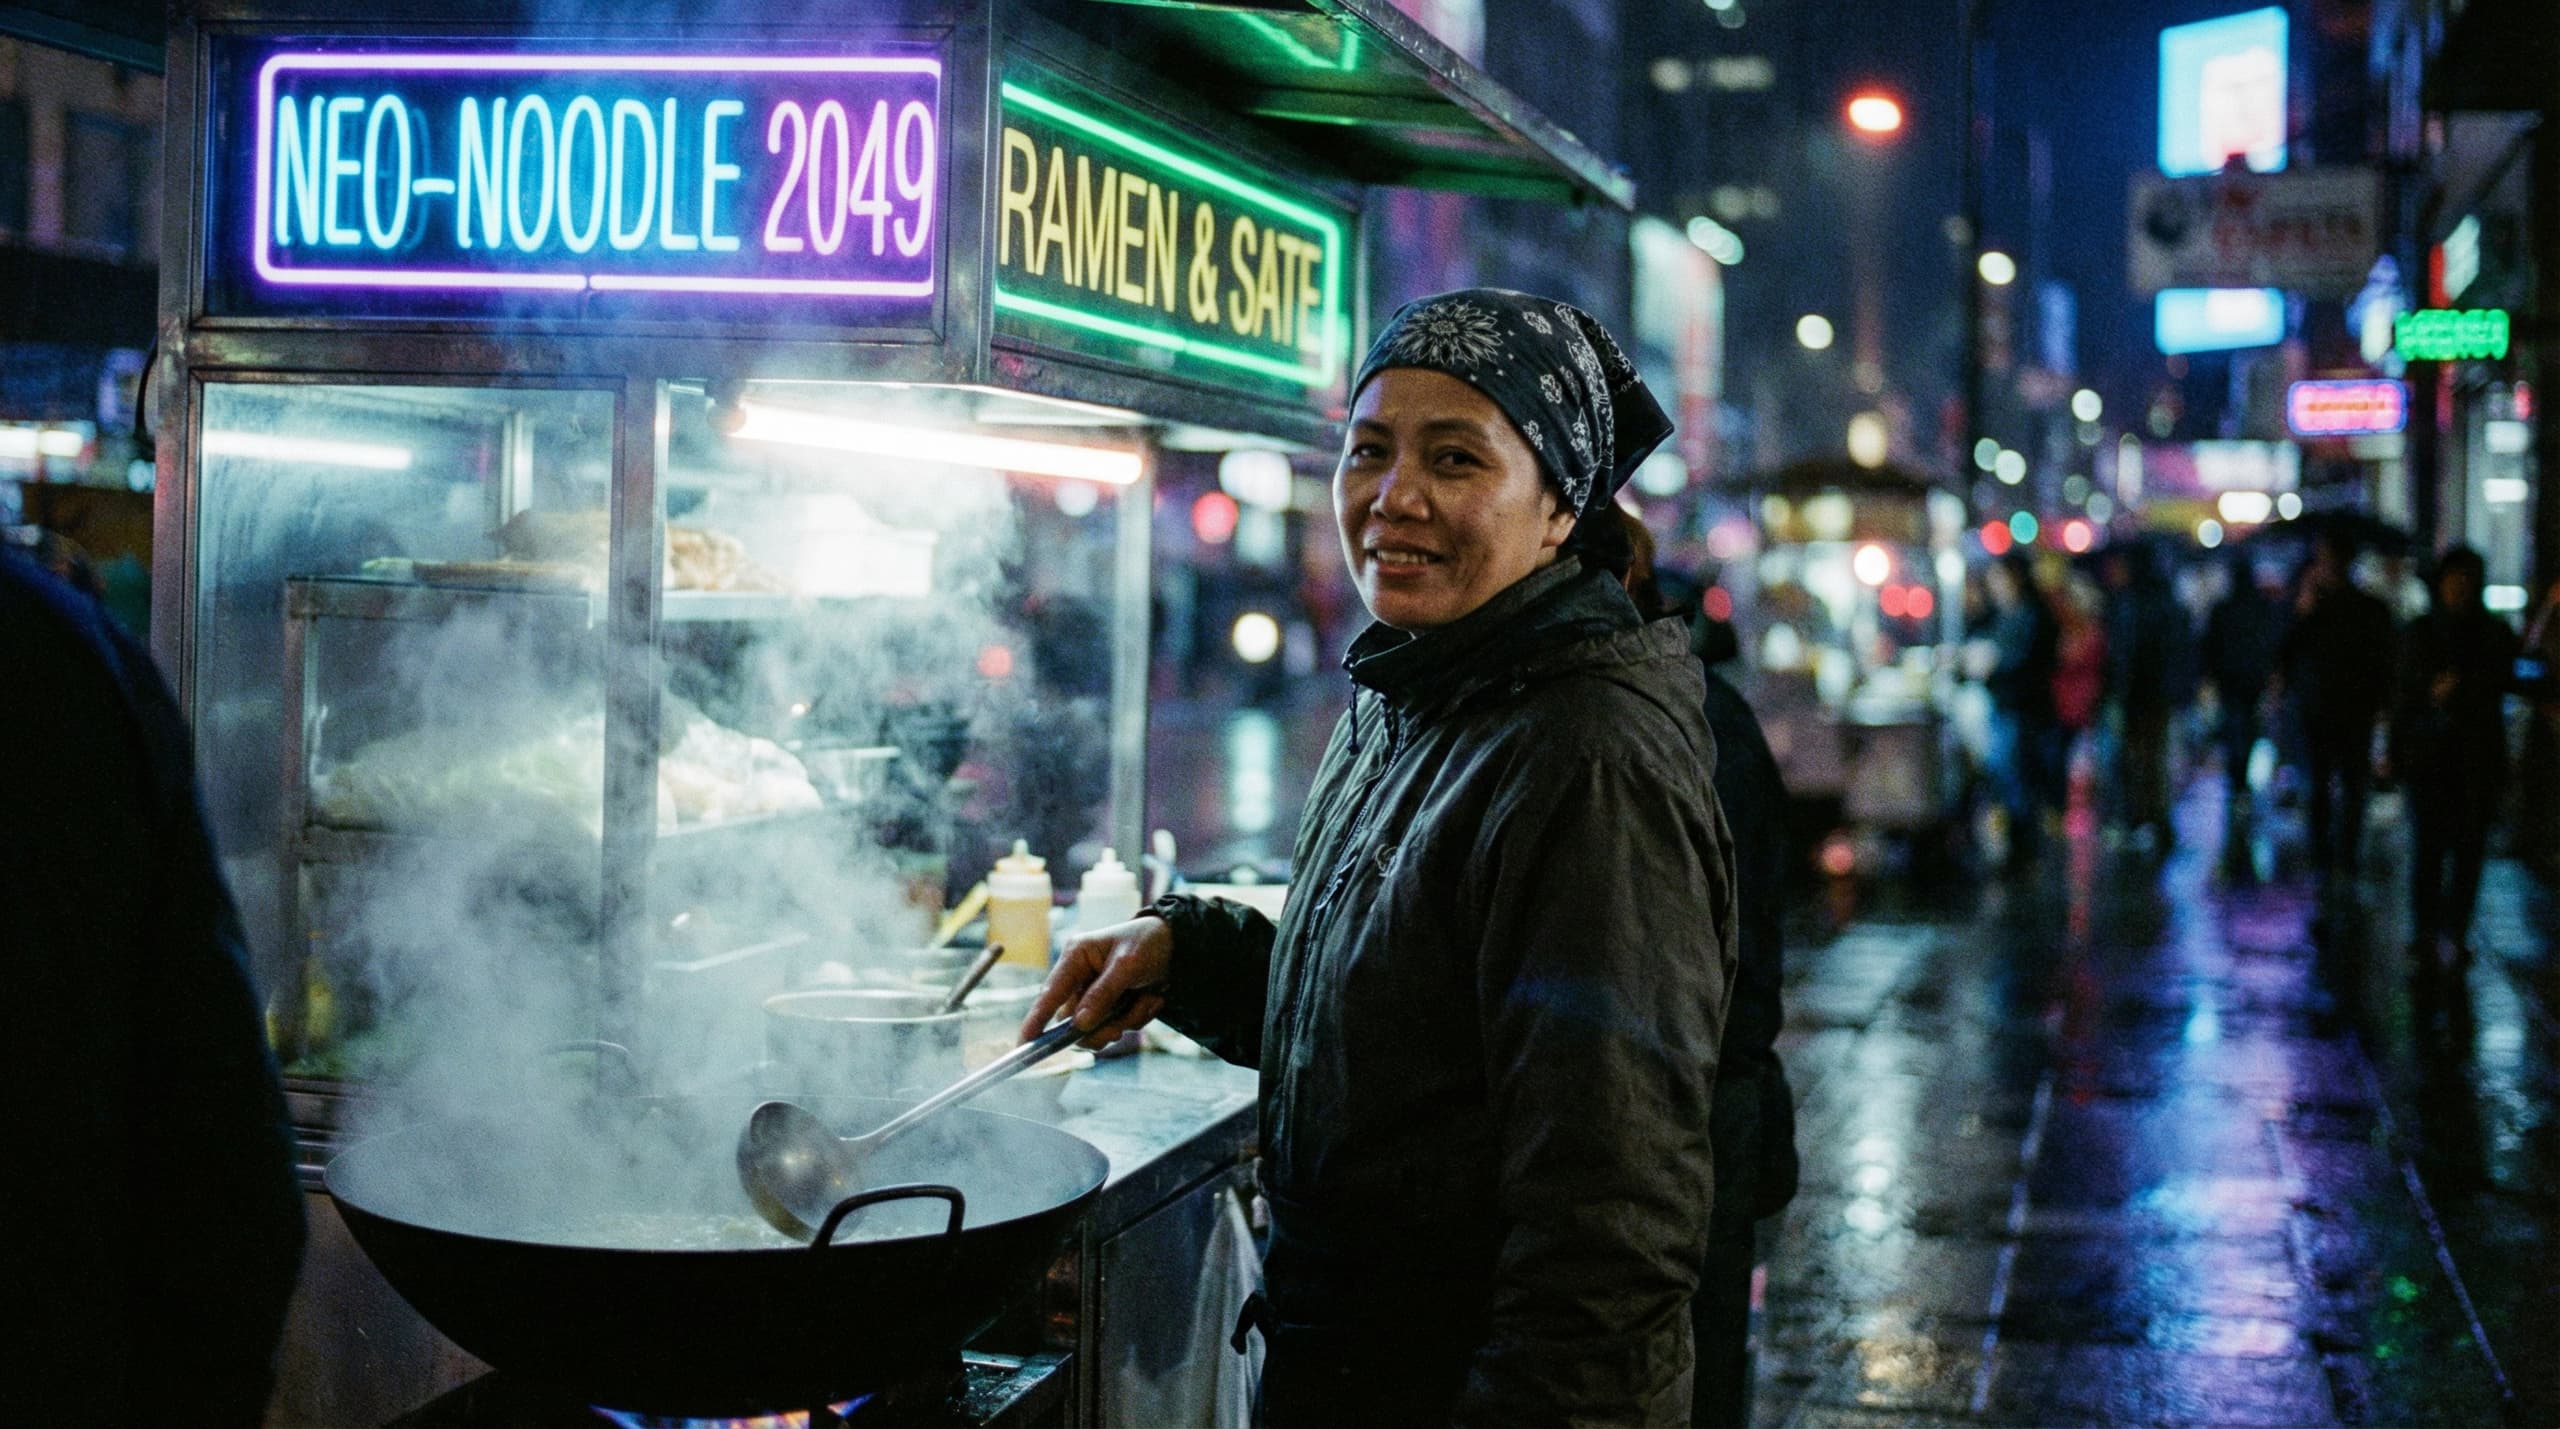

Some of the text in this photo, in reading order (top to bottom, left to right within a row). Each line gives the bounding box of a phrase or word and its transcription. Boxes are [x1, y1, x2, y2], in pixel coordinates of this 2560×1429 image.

[274, 94, 935, 258] NEO-NOODLE 2049
[1000, 126, 1323, 354] RAMEN & SATE
